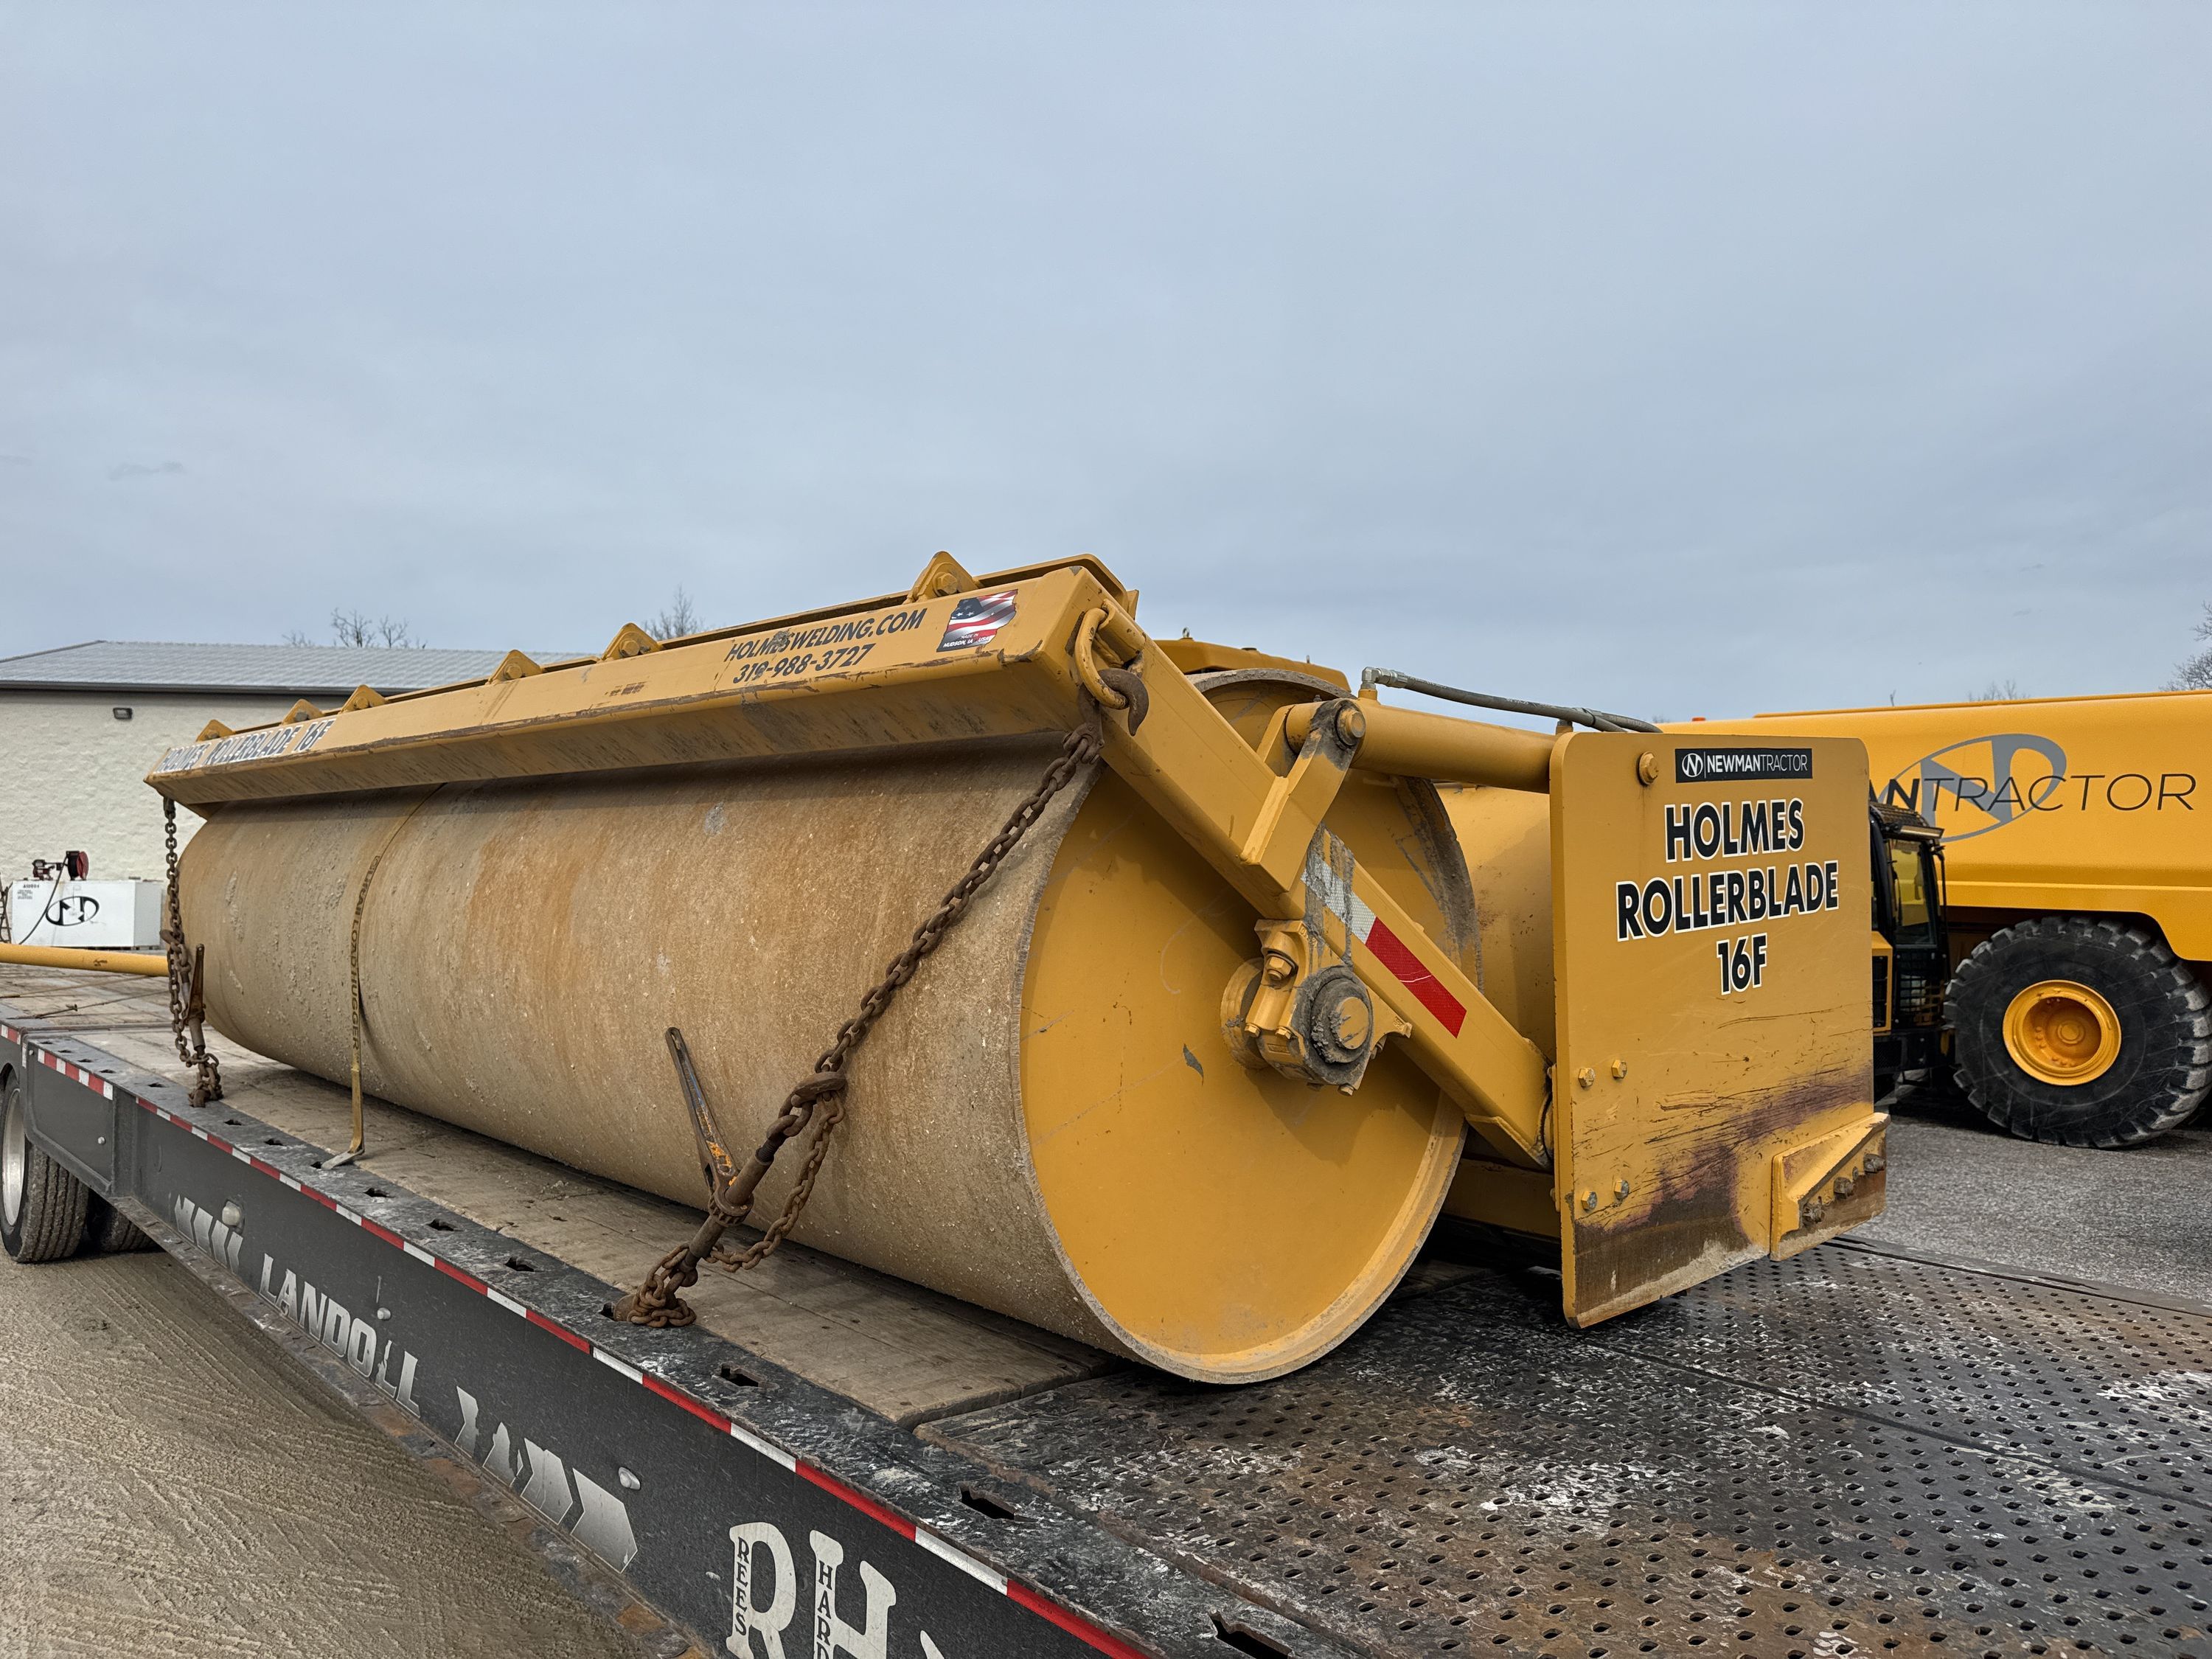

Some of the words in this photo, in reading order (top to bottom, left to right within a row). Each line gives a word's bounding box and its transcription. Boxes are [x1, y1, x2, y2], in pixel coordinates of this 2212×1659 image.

[723, 608, 928, 662] HOLMSWELDING.COM
[152, 742, 212, 773] HOLMES
[199, 724, 304, 768] ROLLERBLADE
[291, 717, 337, 754] 16F
[1707, 754, 1808, 773] NEWMANTRACTOR
[1664, 798, 1804, 863] HOLMES
[1615, 860, 1840, 942] ROLLERBLADE
[1717, 933, 1768, 995] 16F
[258, 1253, 421, 1418] LANDOLL
[734, 1537, 750, 1636] REES
